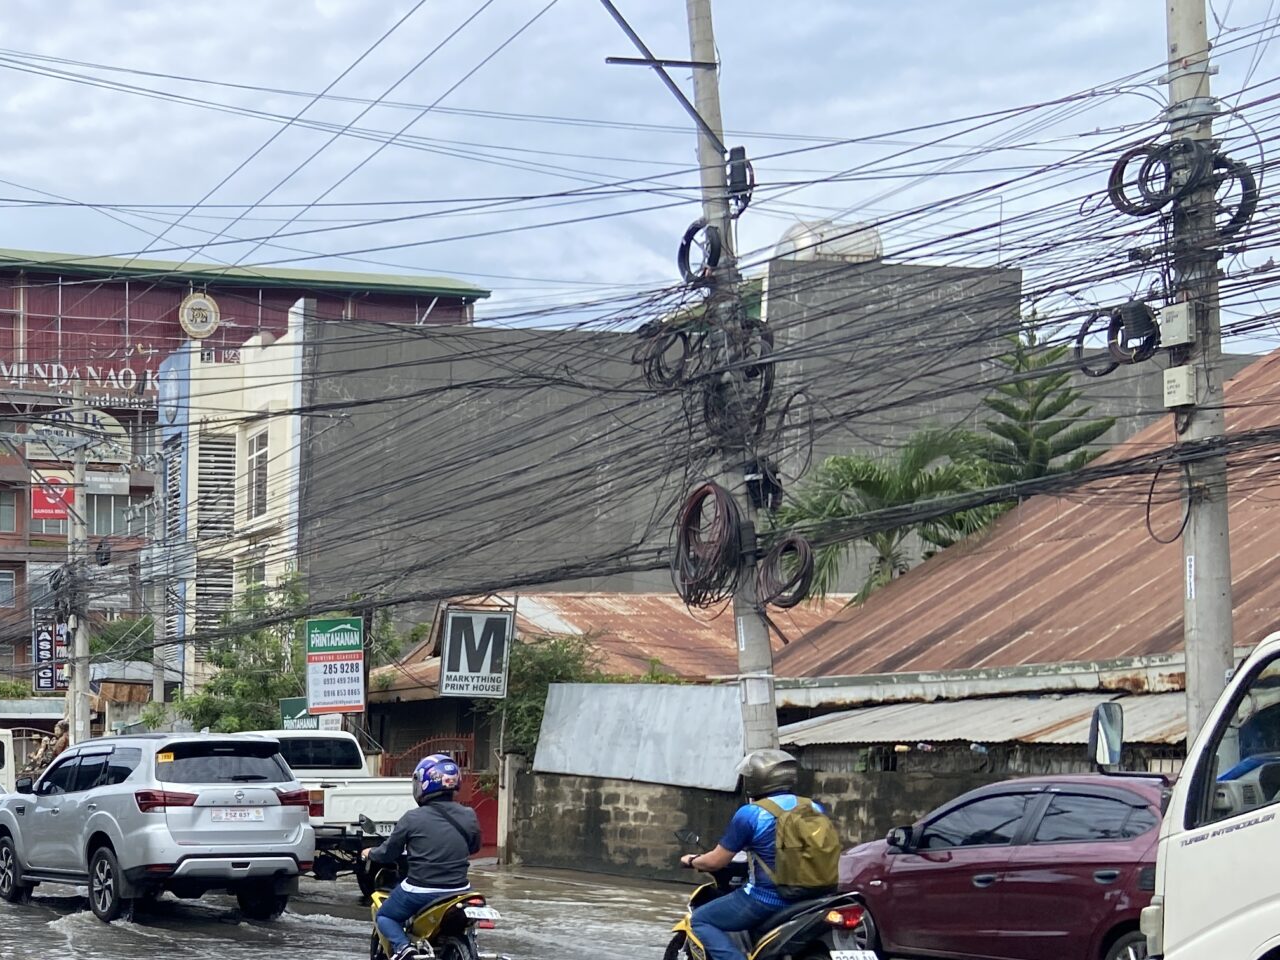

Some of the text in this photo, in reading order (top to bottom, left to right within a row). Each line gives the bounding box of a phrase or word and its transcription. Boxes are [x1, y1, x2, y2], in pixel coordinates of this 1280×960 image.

[310, 631, 360, 648] PRINTAHANAN
[447, 616, 507, 674] M
[323, 662, 360, 675] 285 9288
[445, 674, 502, 684] MARKYTHING
[444, 683, 501, 692] PRINT HOUSE
[1179, 812, 1276, 847] TURBO INTERCOOLER
